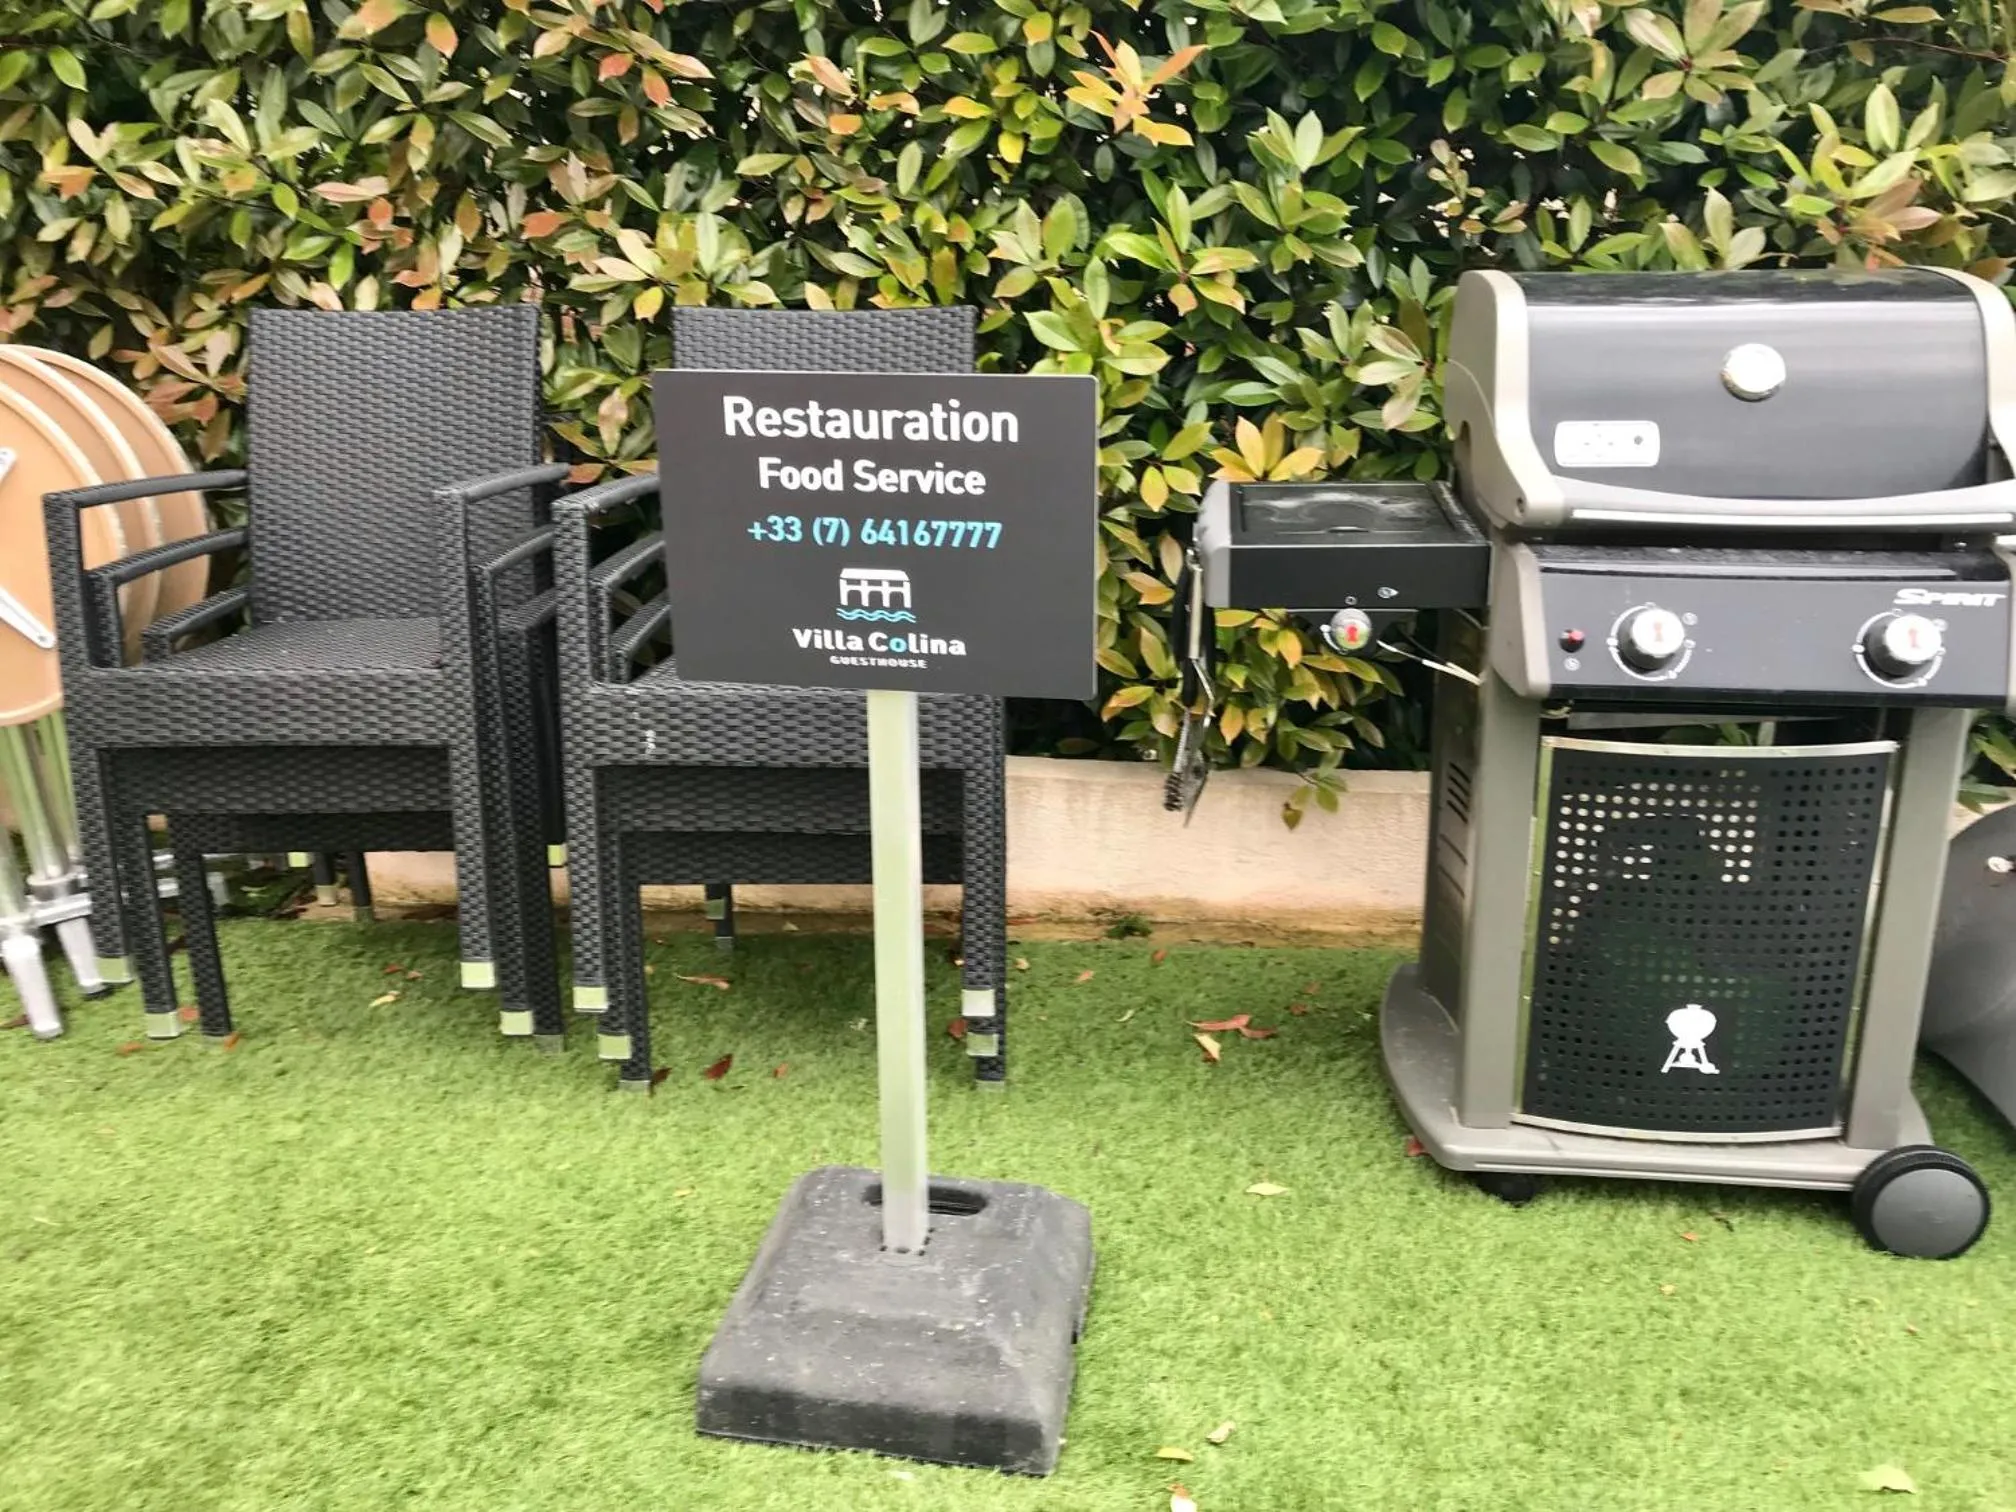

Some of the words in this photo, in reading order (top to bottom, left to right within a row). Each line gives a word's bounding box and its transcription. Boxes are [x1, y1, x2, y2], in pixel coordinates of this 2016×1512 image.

[722, 395, 1018, 442] Restauration
[758, 456, 843, 491] Food
[853, 460, 986, 495] Service
[747, 514, 803, 544] +33
[812, 516, 851, 547] (7)
[860, 518, 1002, 549] 64167777
[792, 628, 864, 652] Villa
[868, 631, 967, 656] Colina
[829, 655, 928, 669] GUESTHOUSE
